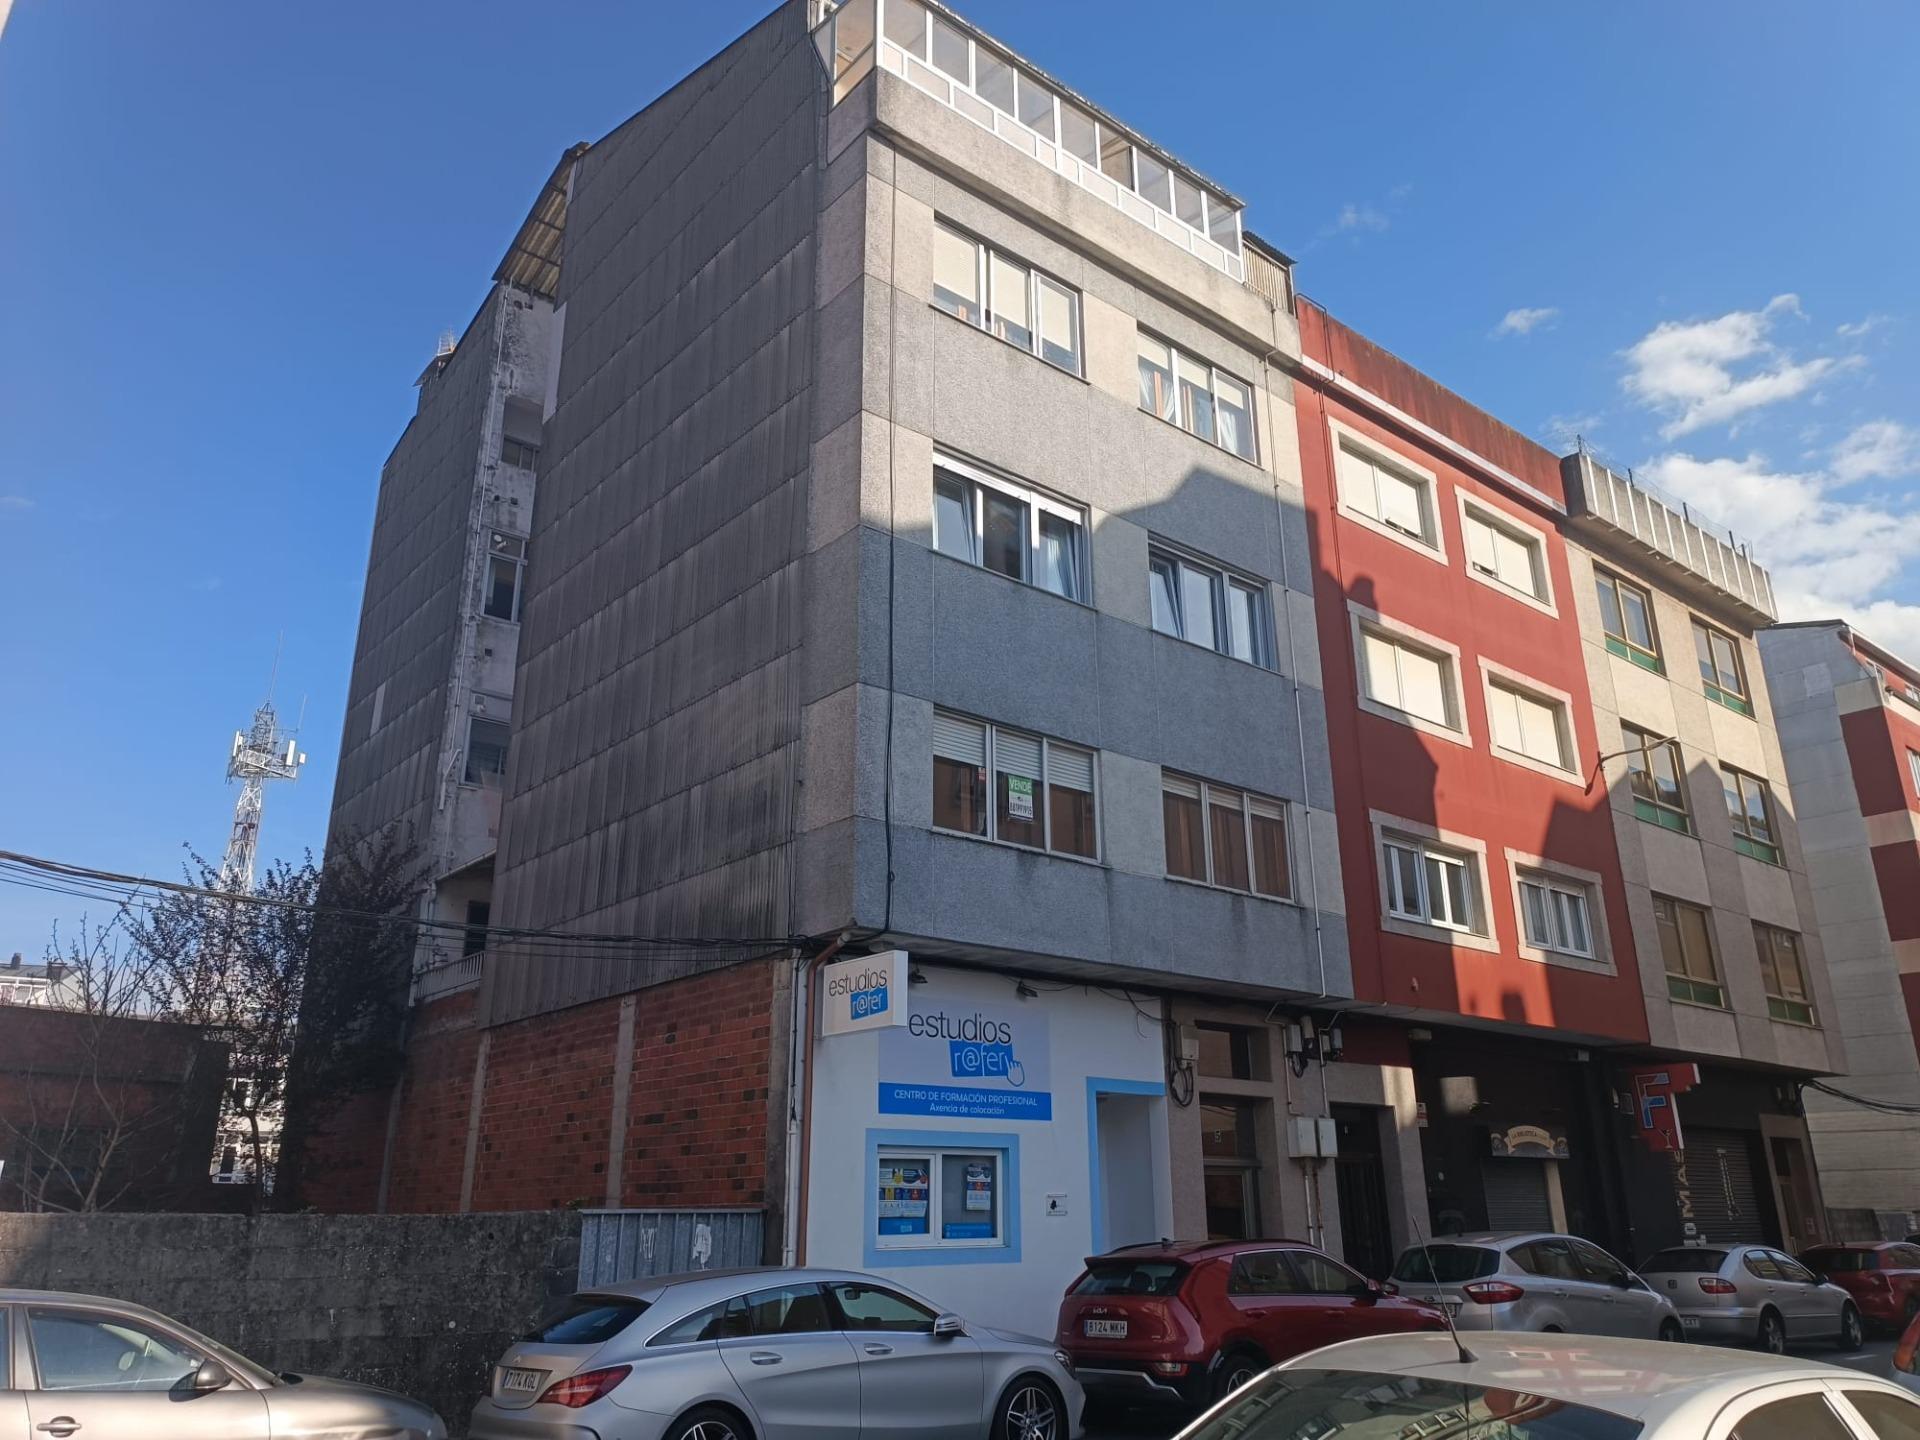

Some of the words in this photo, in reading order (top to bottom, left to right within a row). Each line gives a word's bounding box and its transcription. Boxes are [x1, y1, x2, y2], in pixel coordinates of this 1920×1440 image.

[828, 968, 887, 997] estudios
[852, 989, 883, 1016] r@fer
[909, 1012, 1011, 1044] estudios
[954, 1044, 1007, 1076] r@fer
[894, 1089, 927, 1100] CENTRO
[928, 1091, 940, 1101] DE
[940, 1091, 987, 1104] FORMACIÓN
[988, 1094, 1038, 1106] PROFESIONAL
[929, 1102, 958, 1113] Axencia
[960, 1104, 969, 1113] de
[970, 1104, 1005, 1115] colocación
